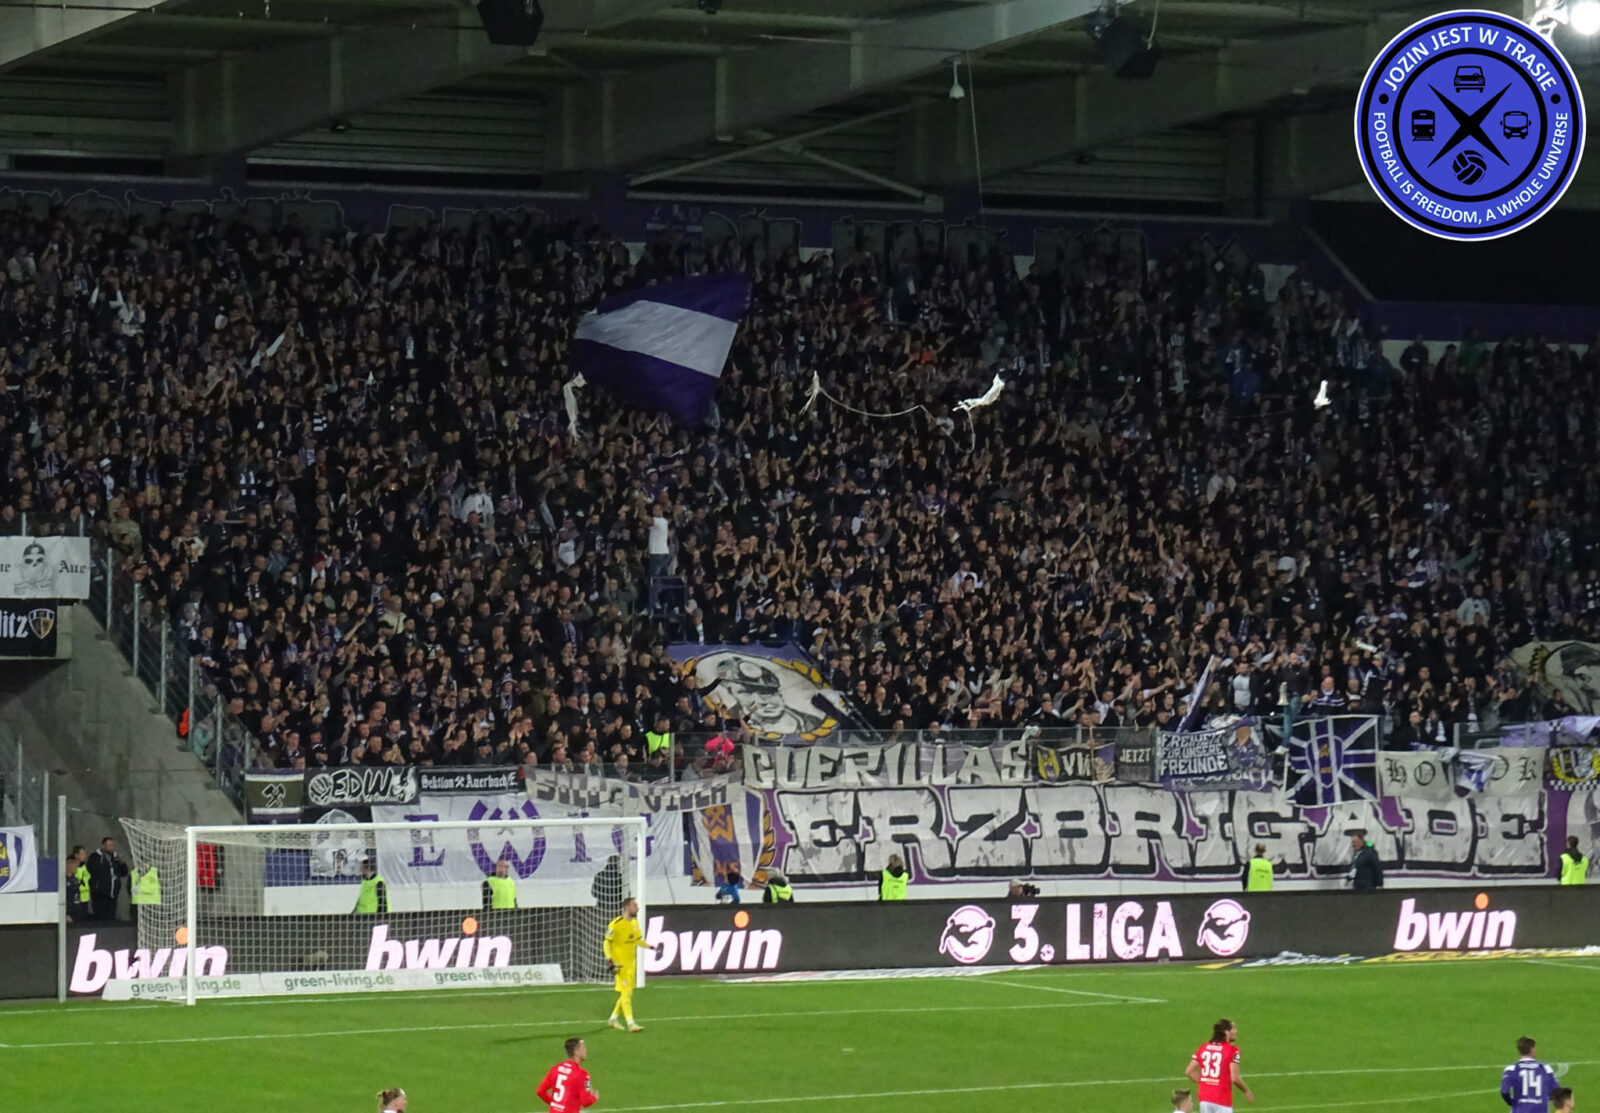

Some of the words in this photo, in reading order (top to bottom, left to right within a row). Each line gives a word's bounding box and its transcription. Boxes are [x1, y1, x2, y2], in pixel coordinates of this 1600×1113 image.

[1120, 747, 1151, 763] JETZT
[1160, 754, 1228, 776] FREUNDE
[776, 785, 1547, 881] ERZBRIGADE
[1009, 904, 1055, 963] 3.
[1066, 901, 1183, 960] LIGA
[1393, 893, 1517, 951] bwin
[365, 916, 512, 971] bwin
[644, 910, 783, 973] bwin
[69, 926, 228, 993] bwin
[284, 972, 395, 991] green-living.de
[434, 967, 543, 985] green-living.de
[1201, 1051, 1222, 1078] 33
[553, 1073, 568, 1102] 5
[1519, 1069, 1542, 1097] 14
